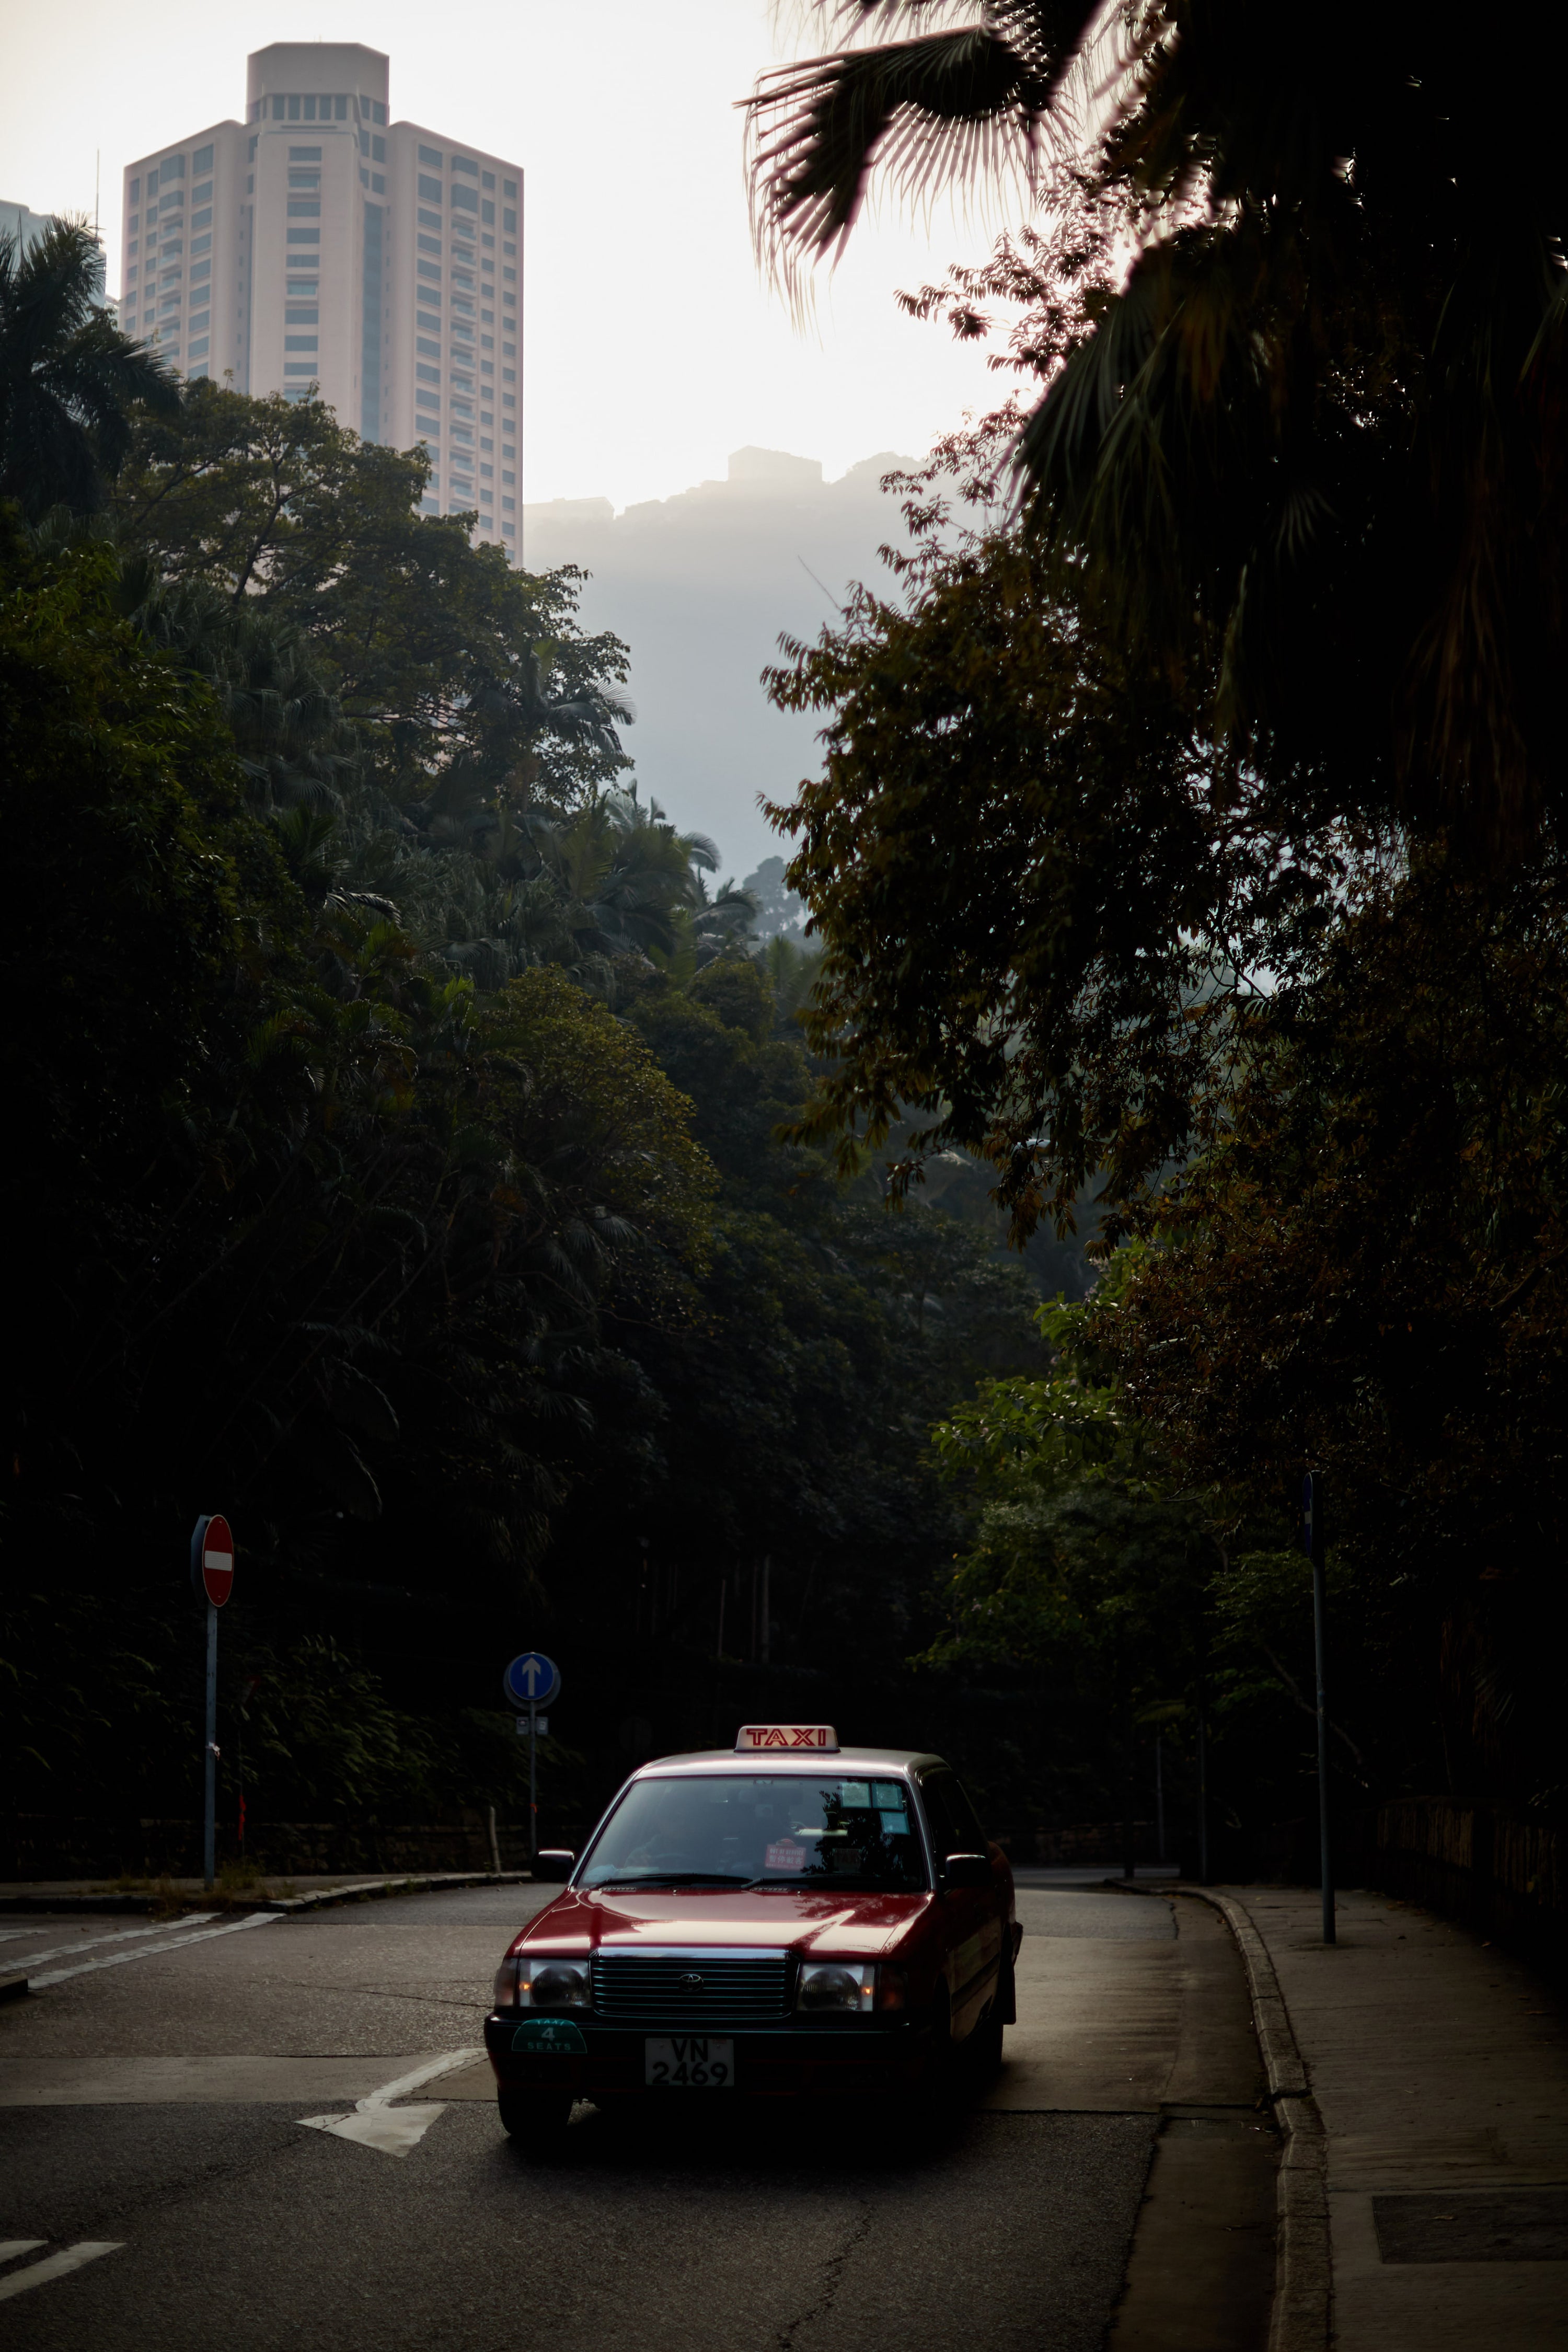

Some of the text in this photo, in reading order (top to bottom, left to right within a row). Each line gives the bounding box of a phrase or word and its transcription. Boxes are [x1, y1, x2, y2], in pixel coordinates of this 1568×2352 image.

[746, 1728, 826, 1746] TAXI
[541, 2026, 555, 2042] 4
[528, 2042, 571, 2050] SEATS
[672, 2039, 708, 2062] VN
[653, 2062, 728, 2085] 2469
